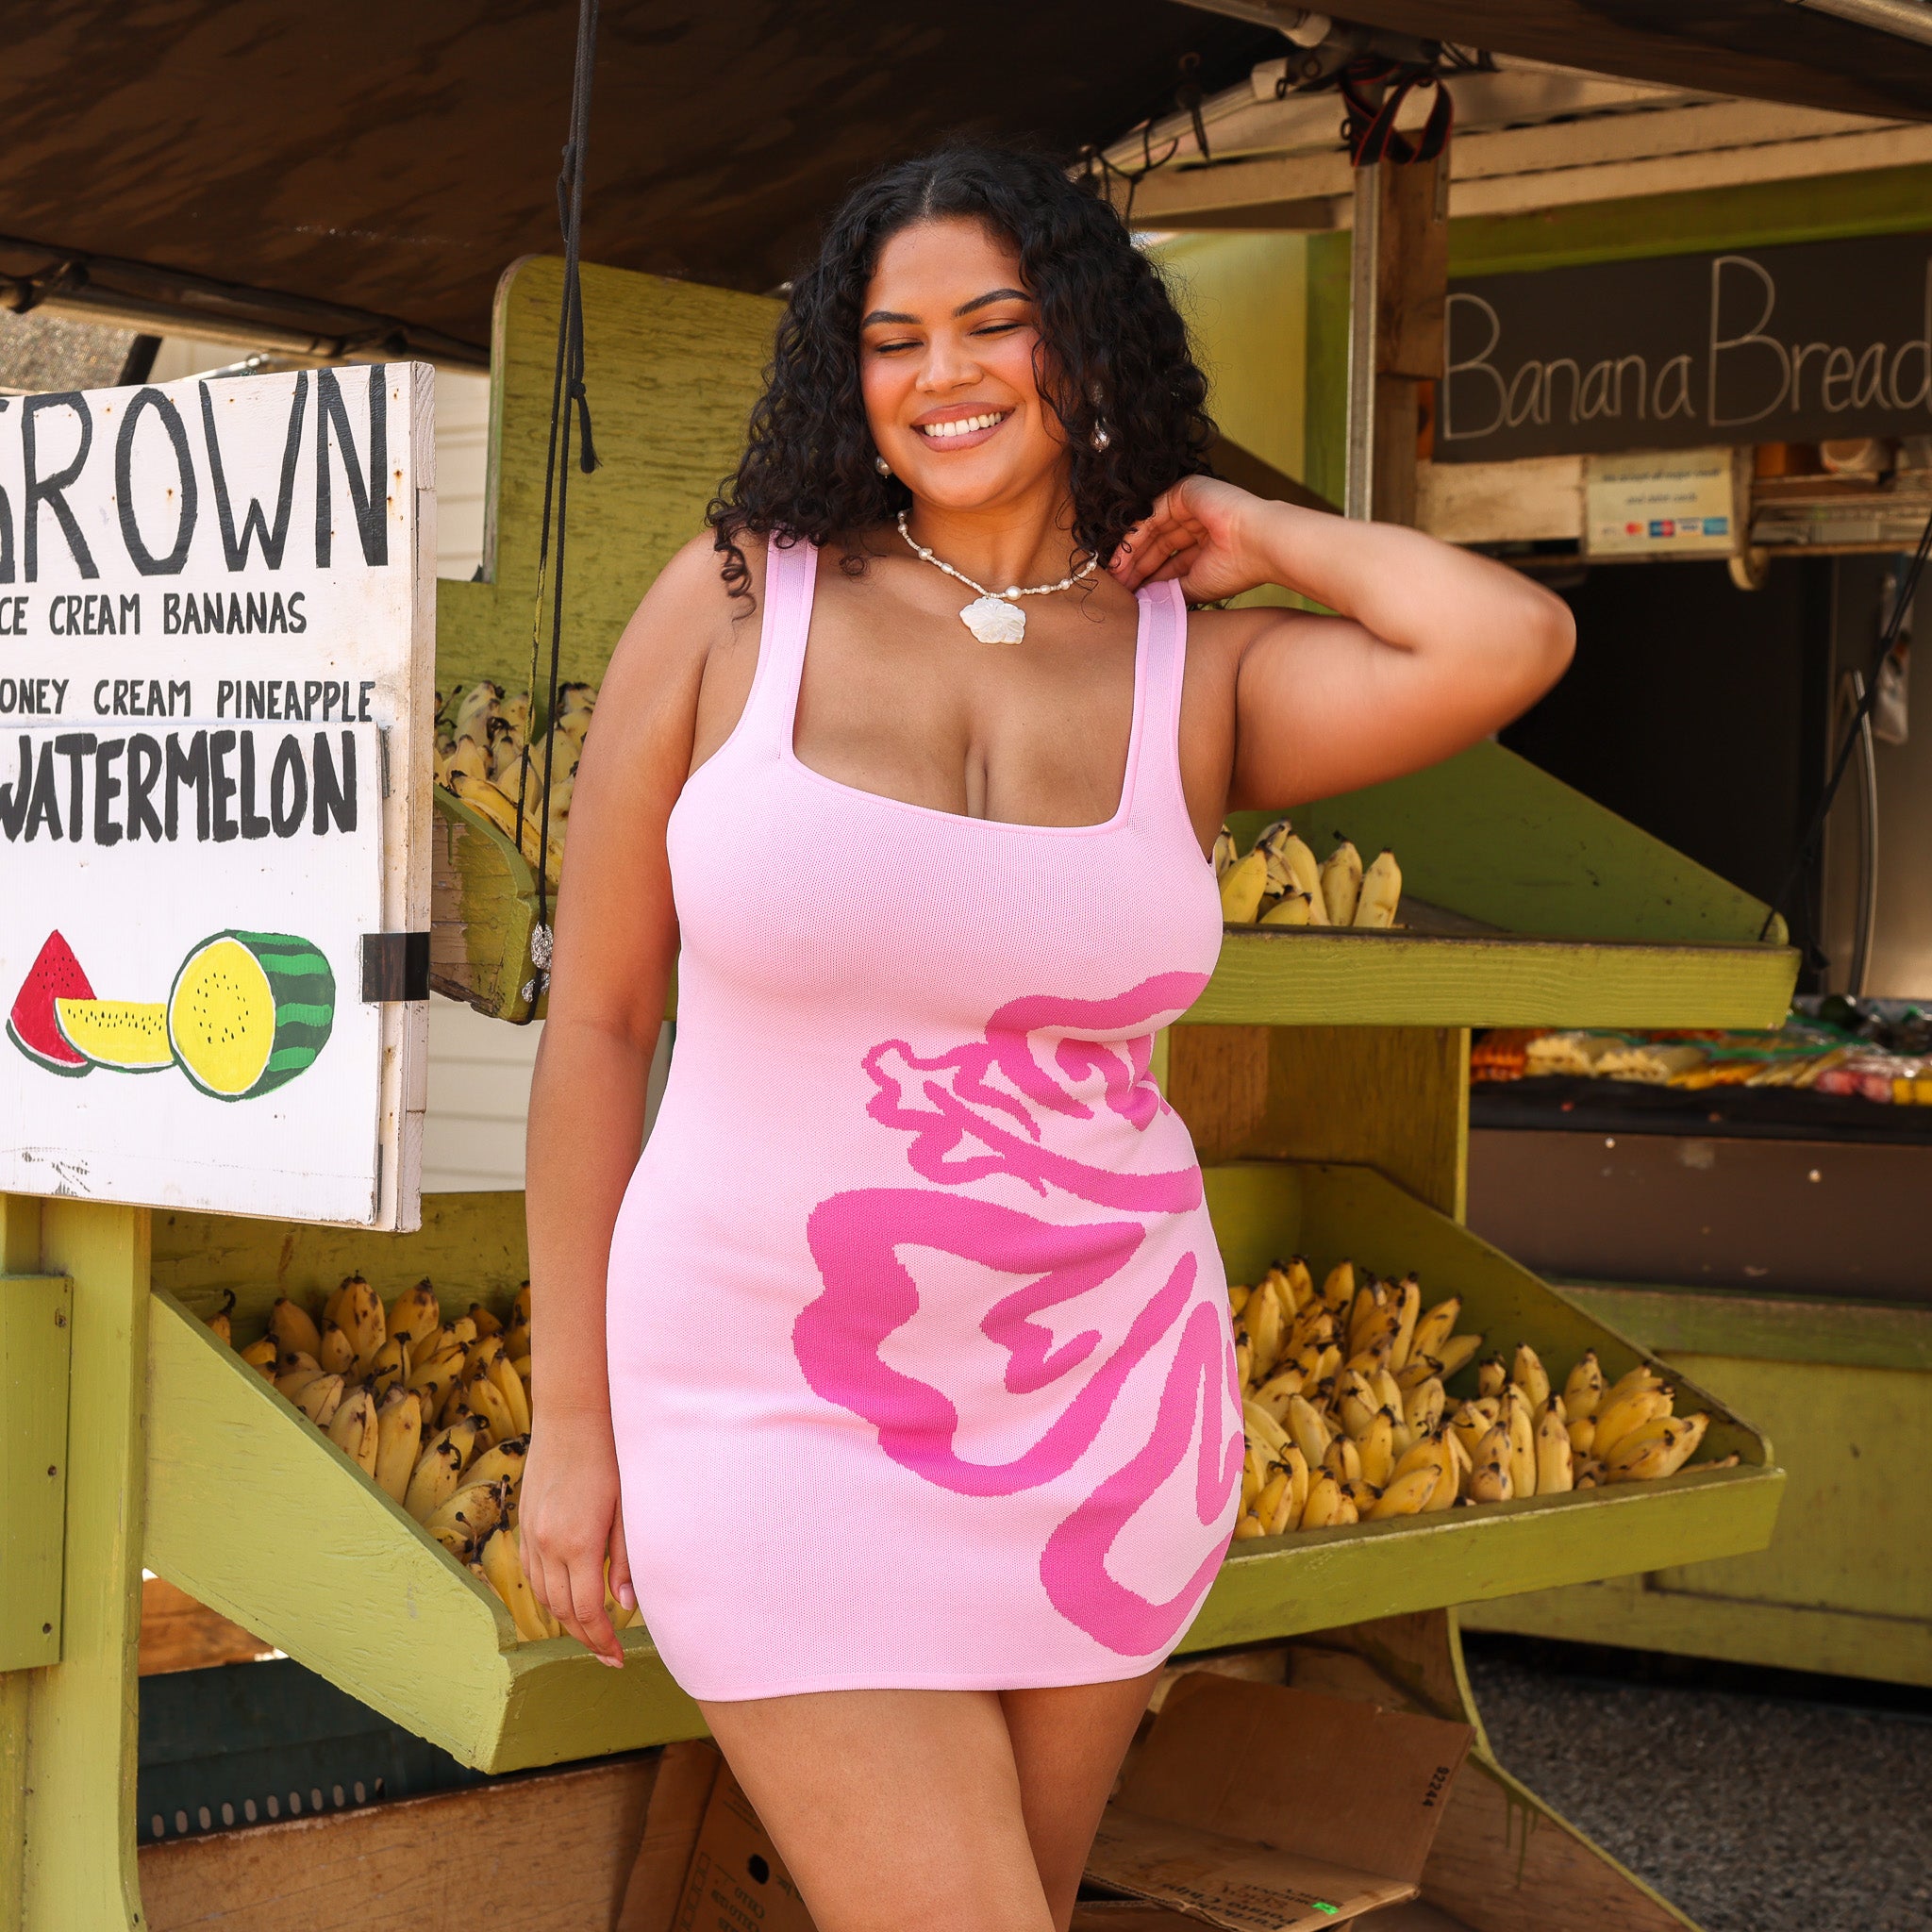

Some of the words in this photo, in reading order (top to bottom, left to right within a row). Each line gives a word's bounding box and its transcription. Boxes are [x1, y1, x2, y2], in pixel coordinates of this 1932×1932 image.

[1443, 292, 1696, 441] Banana
[1707, 255, 1932, 428] Bread
[0, 364, 390, 584] ROWN
[49, 592, 141, 636] CREAM
[163, 591, 308, 635] BANANAS
[93, 678, 192, 717] CREAM
[216, 680, 376, 724] PINEAPPLE
